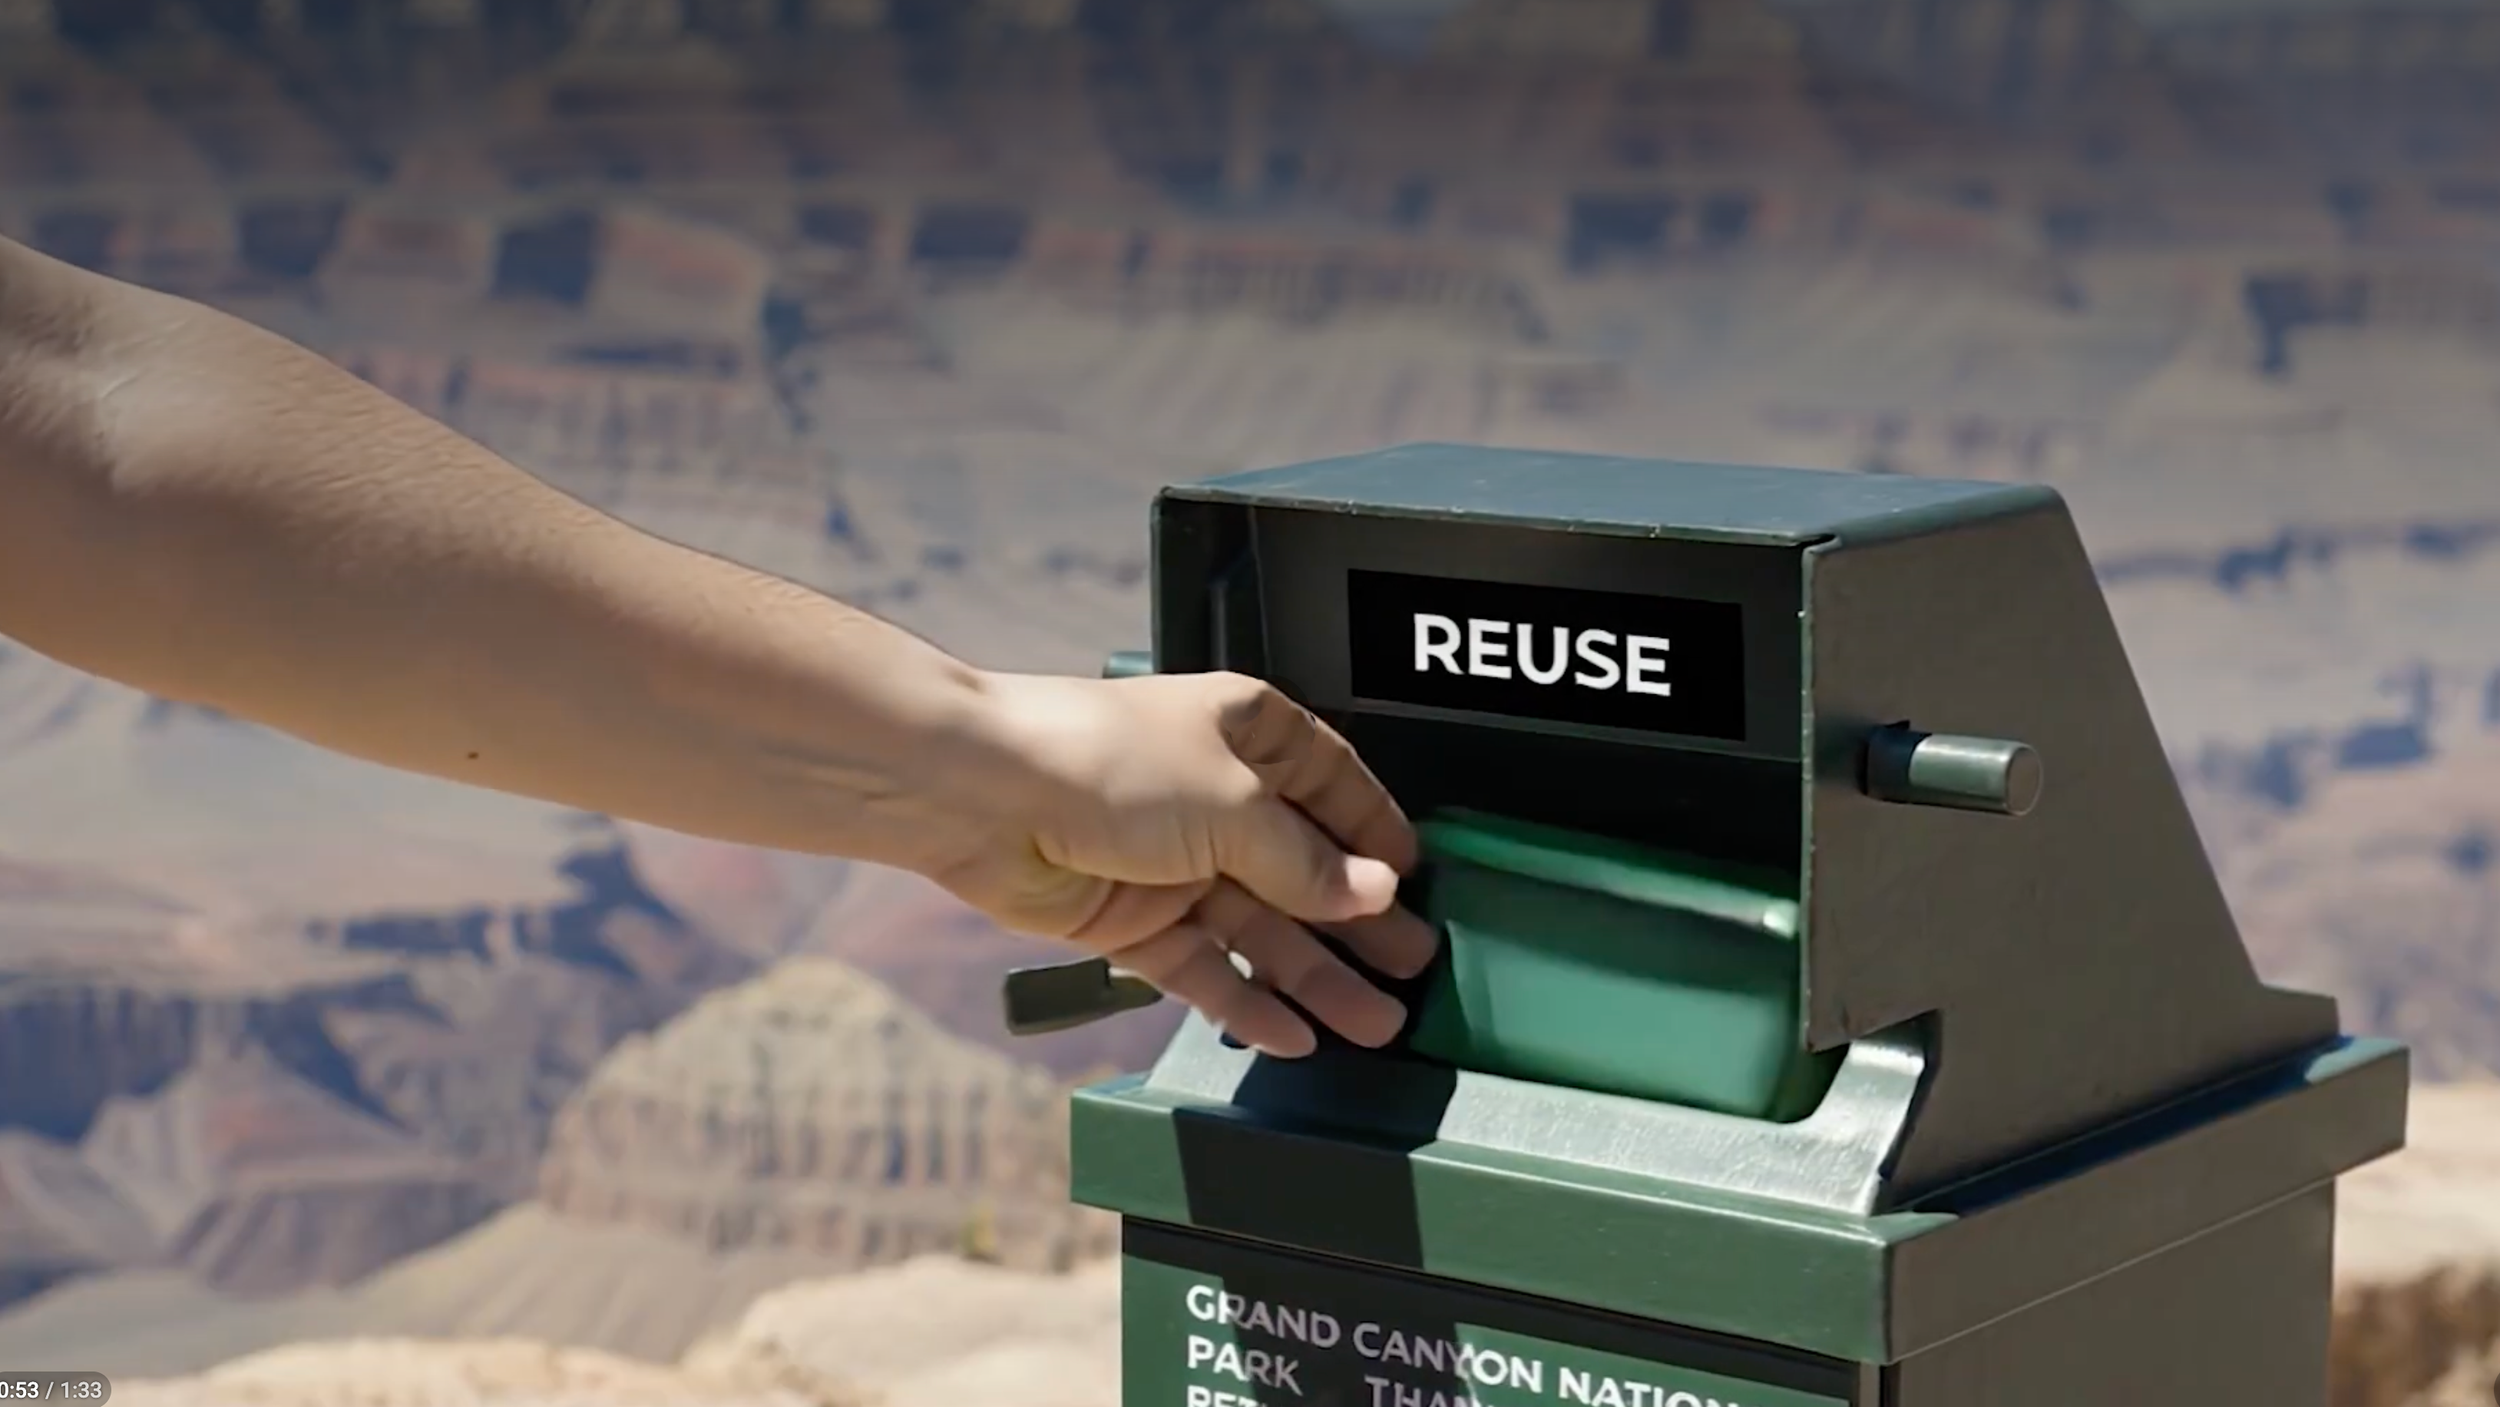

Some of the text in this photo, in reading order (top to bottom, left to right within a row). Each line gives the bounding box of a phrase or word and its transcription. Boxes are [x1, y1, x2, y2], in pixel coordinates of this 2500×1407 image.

[1414, 613, 1671, 696] REUSE
[1186, 1284, 1341, 1348] GRAND
[1353, 1322, 1542, 1393] CANYON
[1187, 1335, 1302, 1396] PARK
